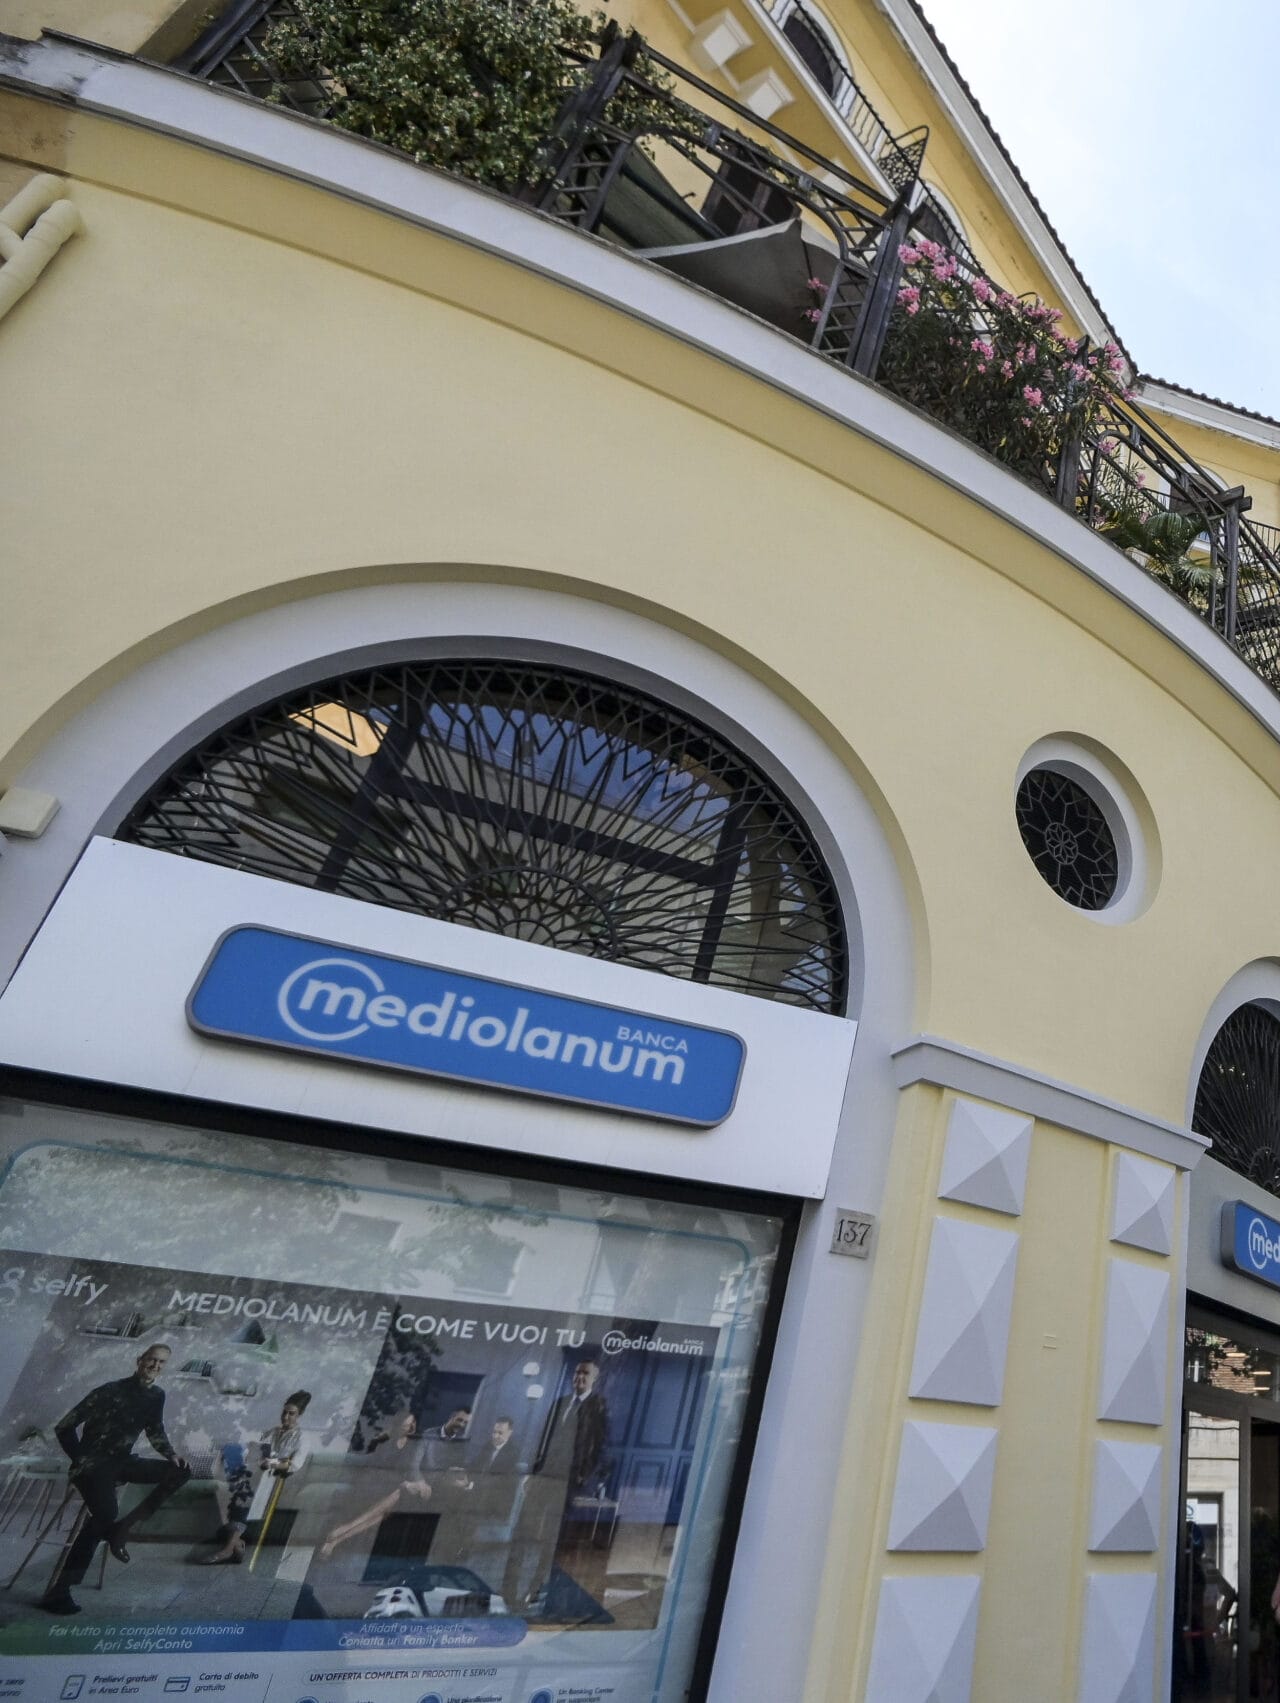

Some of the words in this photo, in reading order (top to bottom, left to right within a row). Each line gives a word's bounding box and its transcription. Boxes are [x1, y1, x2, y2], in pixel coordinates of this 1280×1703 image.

[297, 977, 686, 1085] mediolanum
[616, 1025, 689, 1054] BANCA
[837, 1218, 872, 1246] 137
[28, 1273, 109, 1305] selfy
[167, 1289, 367, 1329] MEDIOLANUM
[373, 1305, 392, 1332] È
[395, 1313, 478, 1340] COME
[483, 1321, 548, 1346] VUOI
[555, 1327, 587, 1349] TU
[606, 1335, 704, 1356] mediolanum
[49, 1624, 68, 1637] Fai
[70, 1625, 100, 1637] tutto
[105, 1624, 116, 1636] in
[181, 1624, 245, 1636] autonomia
[410, 1625, 423, 1633] un
[94, 1638, 121, 1652] Apri
[125, 1638, 193, 1652] SelfyConto
[338, 1635, 384, 1647] Contatta
[387, 1636, 401, 1646] un
[403, 1634, 438, 1648] Family
[441, 1633, 479, 1645] Banker
[93, 1675, 124, 1684] Prelievi
[199, 1672, 222, 1681] Carta
[224, 1672, 232, 1680] di
[234, 1671, 259, 1680] debito
[364, 1670, 409, 1680] COMPLETA
[411, 1670, 419, 1679] DI
[421, 1669, 461, 1679] PRODOTTI
[469, 1667, 497, 1678] SERVIZI
[121, 1686, 139, 1694] Euro
